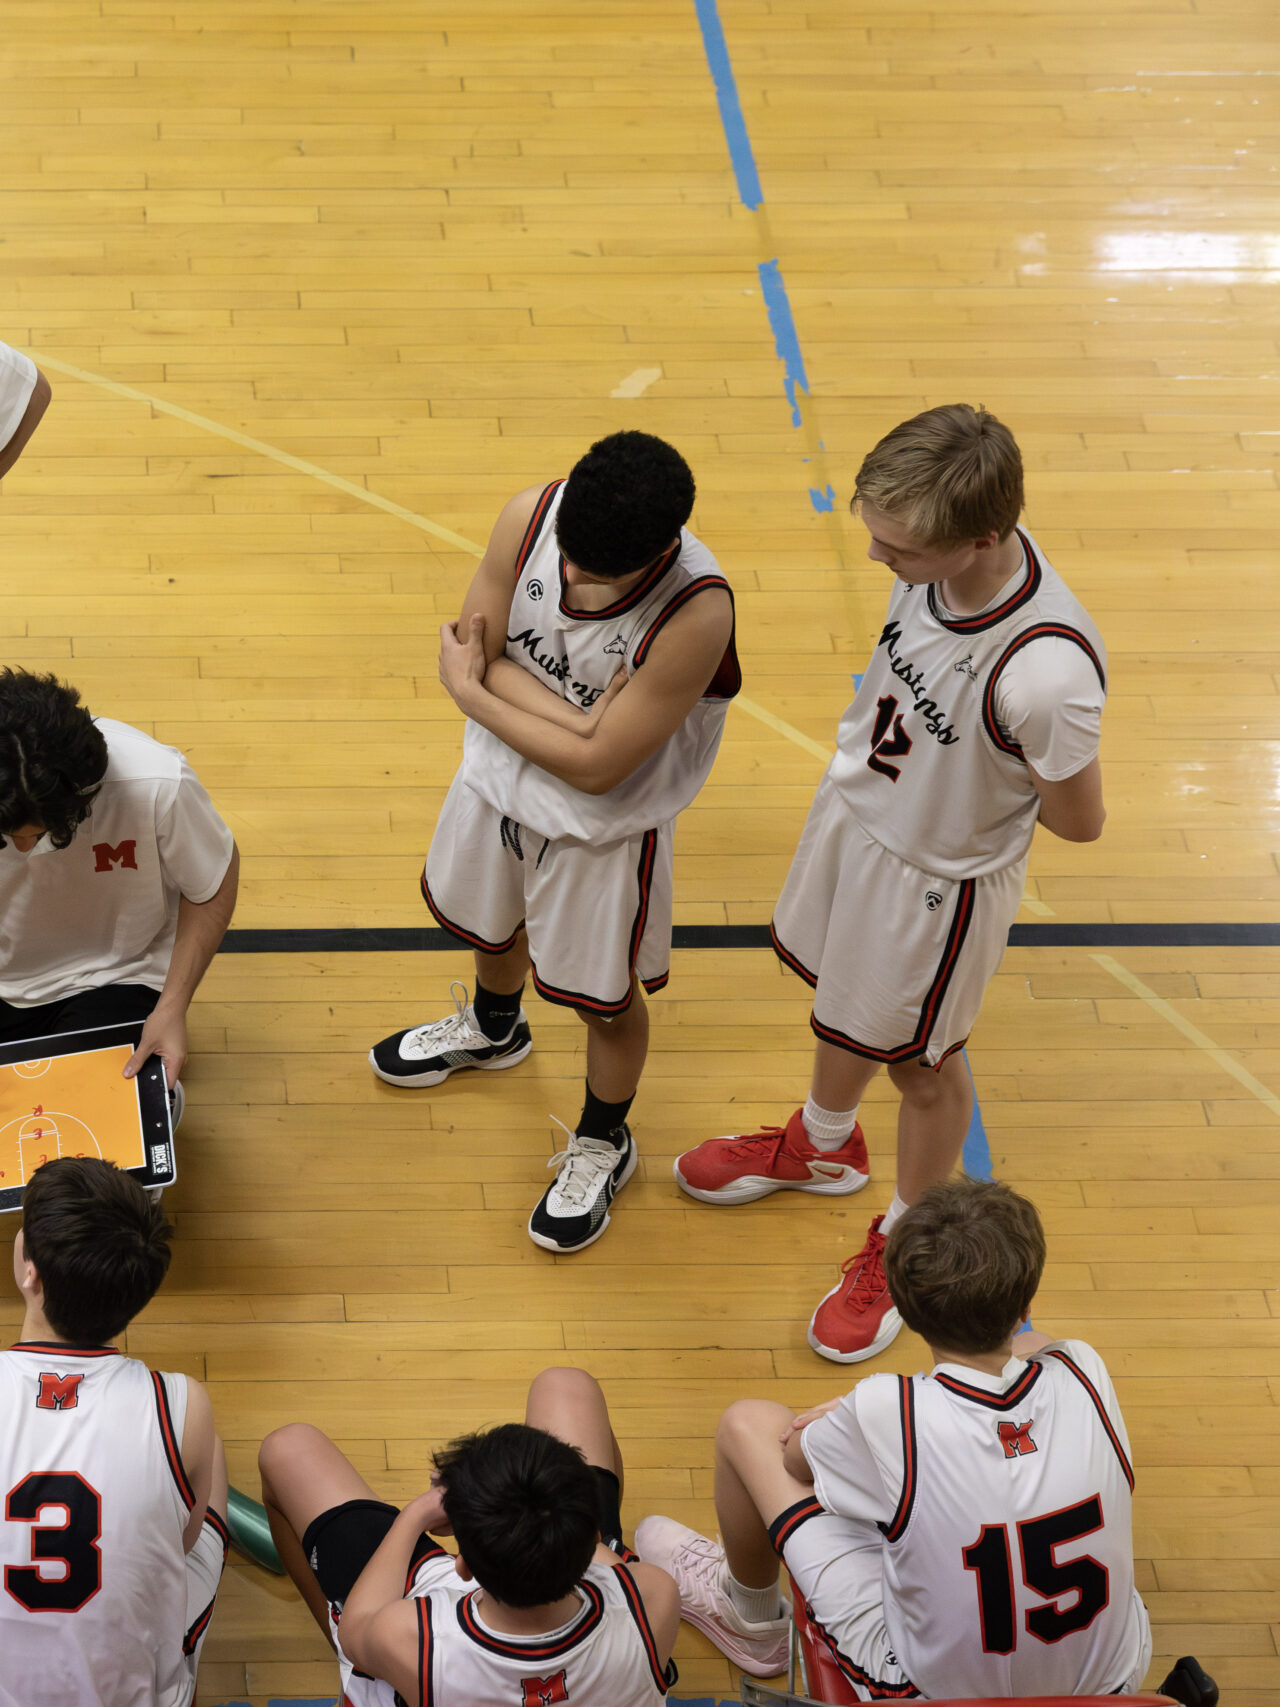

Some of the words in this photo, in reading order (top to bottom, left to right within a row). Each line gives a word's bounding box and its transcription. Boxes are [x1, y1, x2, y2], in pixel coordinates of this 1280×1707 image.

[867, 694, 913, 783] 12
[92, 839, 138, 872] M
[36, 1372, 84, 1410] M
[997, 1419, 1038, 1459] M
[4, 1471, 102, 1613] 3
[961, 1492, 1109, 1656] 15
[521, 1669, 568, 1707] M
